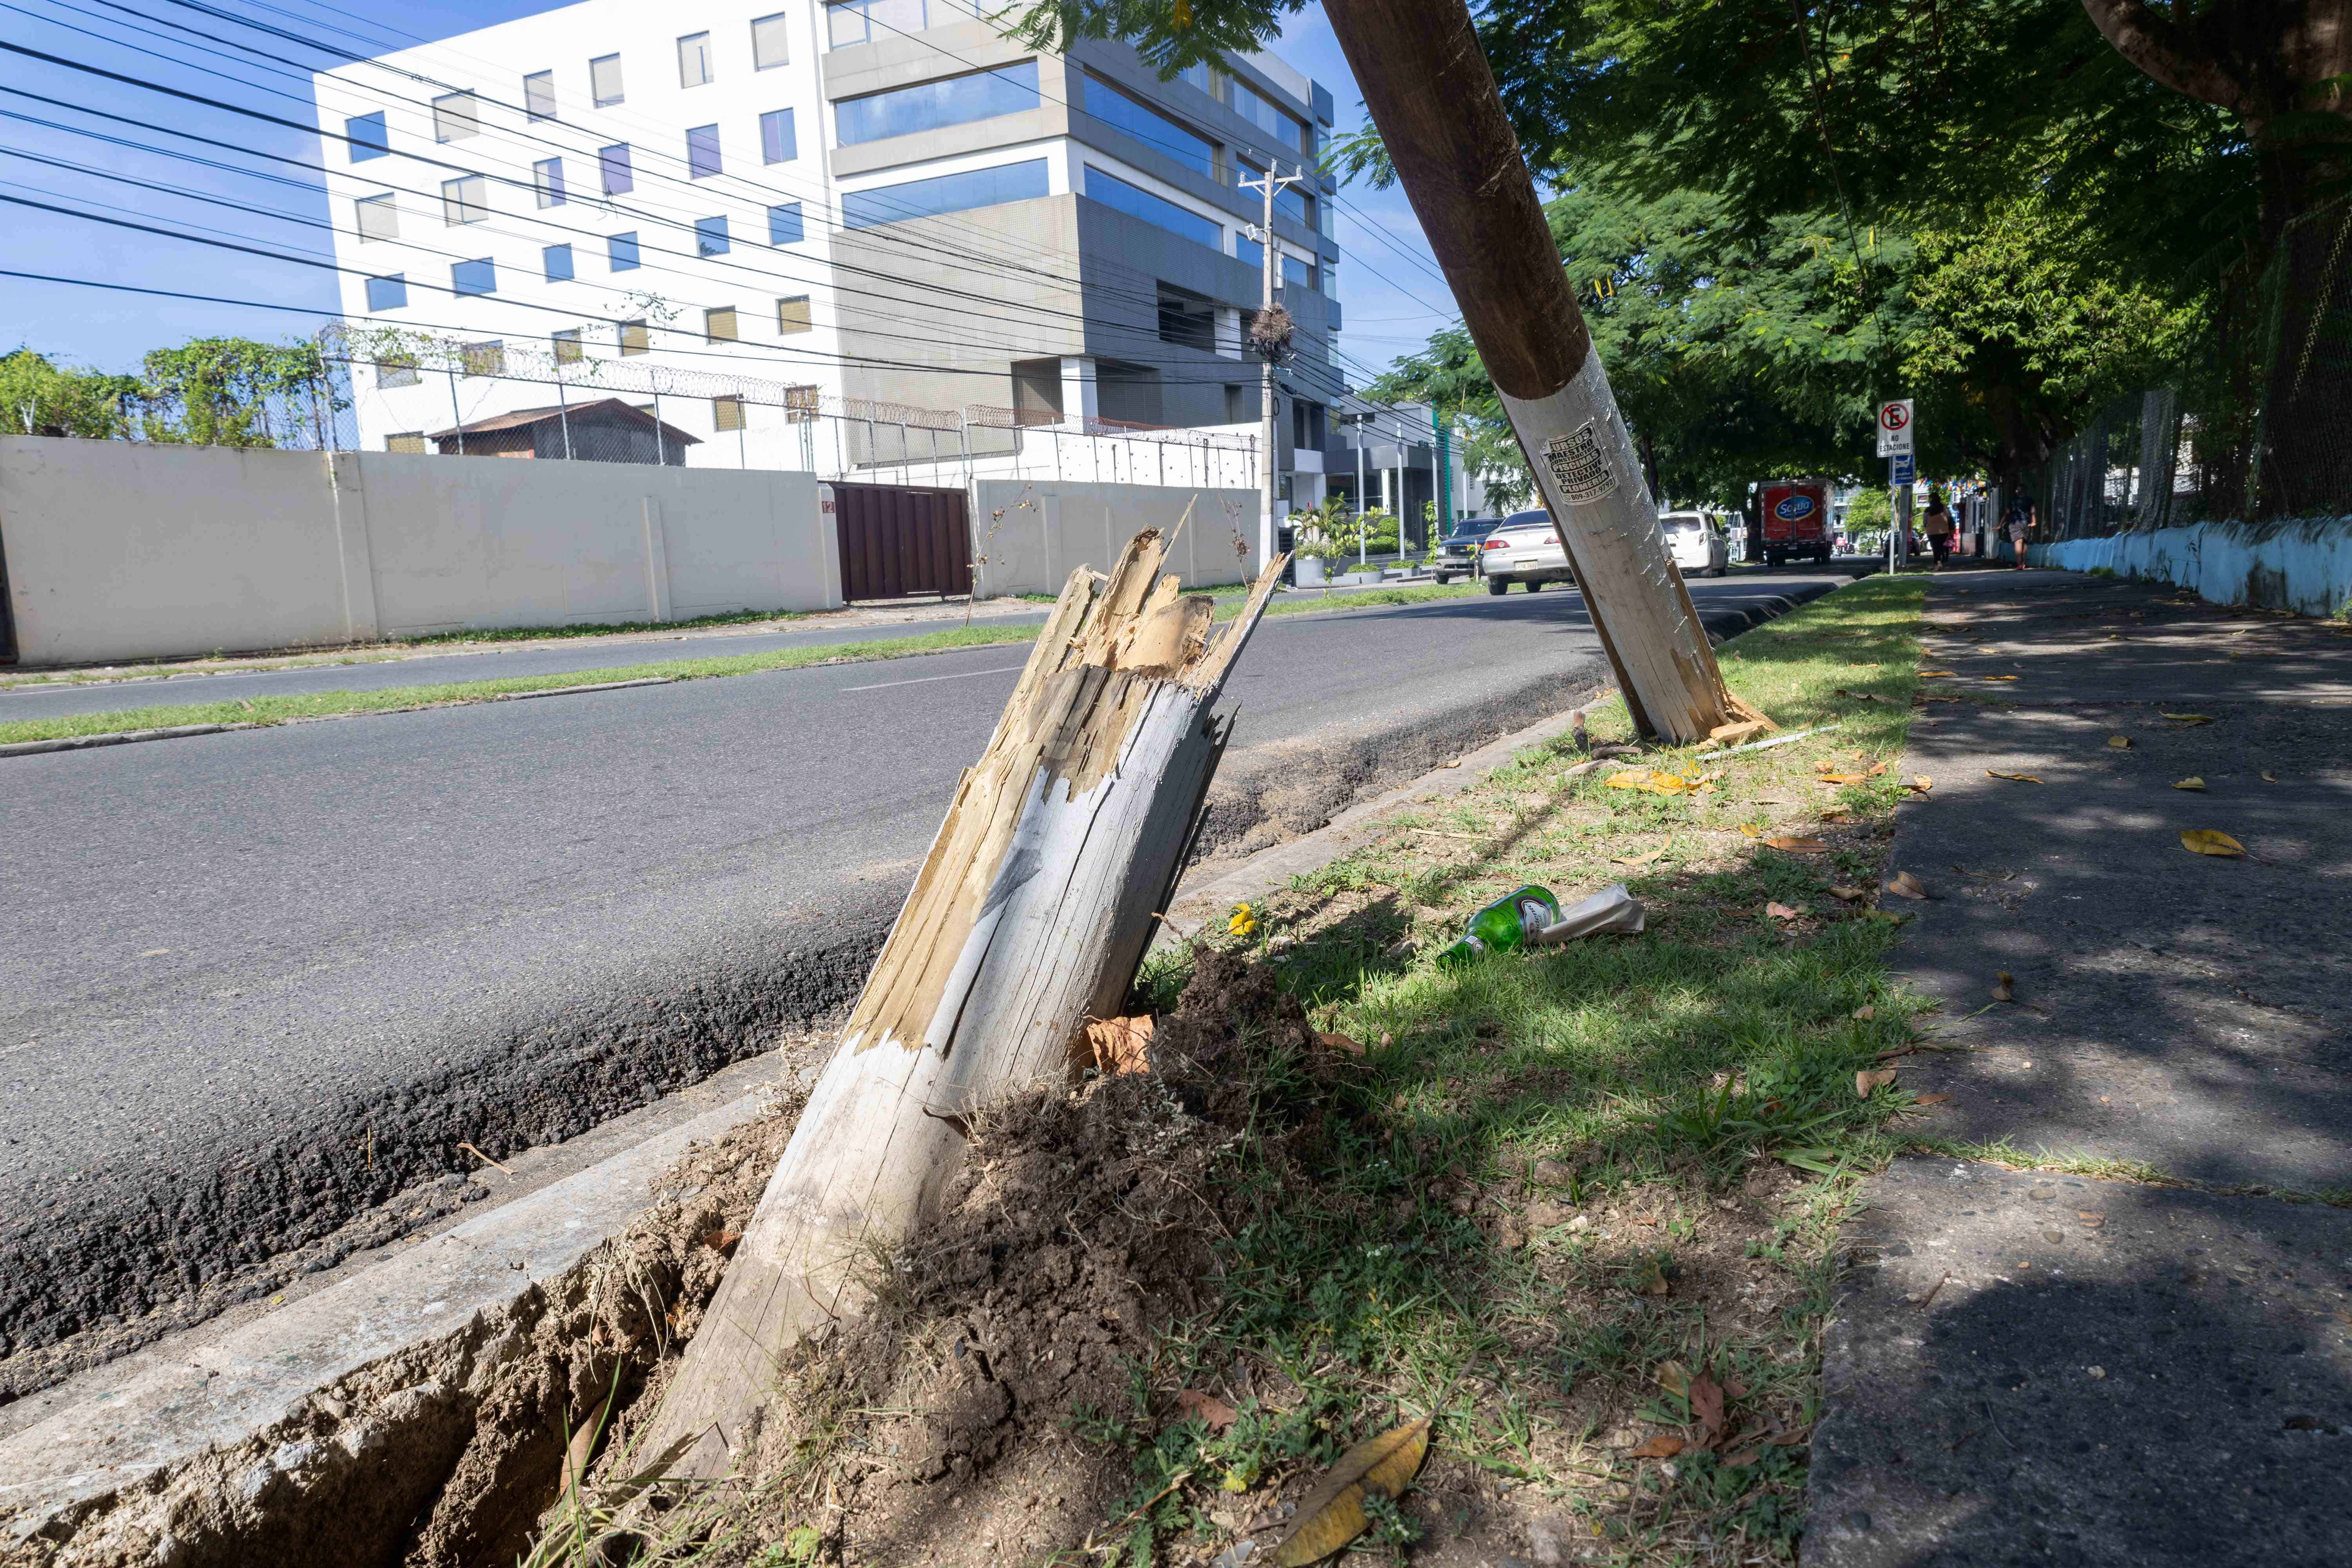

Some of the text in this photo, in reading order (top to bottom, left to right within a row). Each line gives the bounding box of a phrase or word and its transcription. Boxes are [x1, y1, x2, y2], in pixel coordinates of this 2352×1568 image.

[1548, 438, 1593, 462] MAESTRO
[1551, 445, 1595, 466] CONSTRUCTOR
[1880, 443, 1910, 452] ESTACIONE
[1553, 450, 1598, 471] PISCINAS
[1555, 458, 1602, 479] DETECTIVE
[1561, 467, 1601, 485] PRIVADO
[1562, 472, 1607, 493] PLOMERIA
[1571, 479, 1613, 500] 809-317-9792
